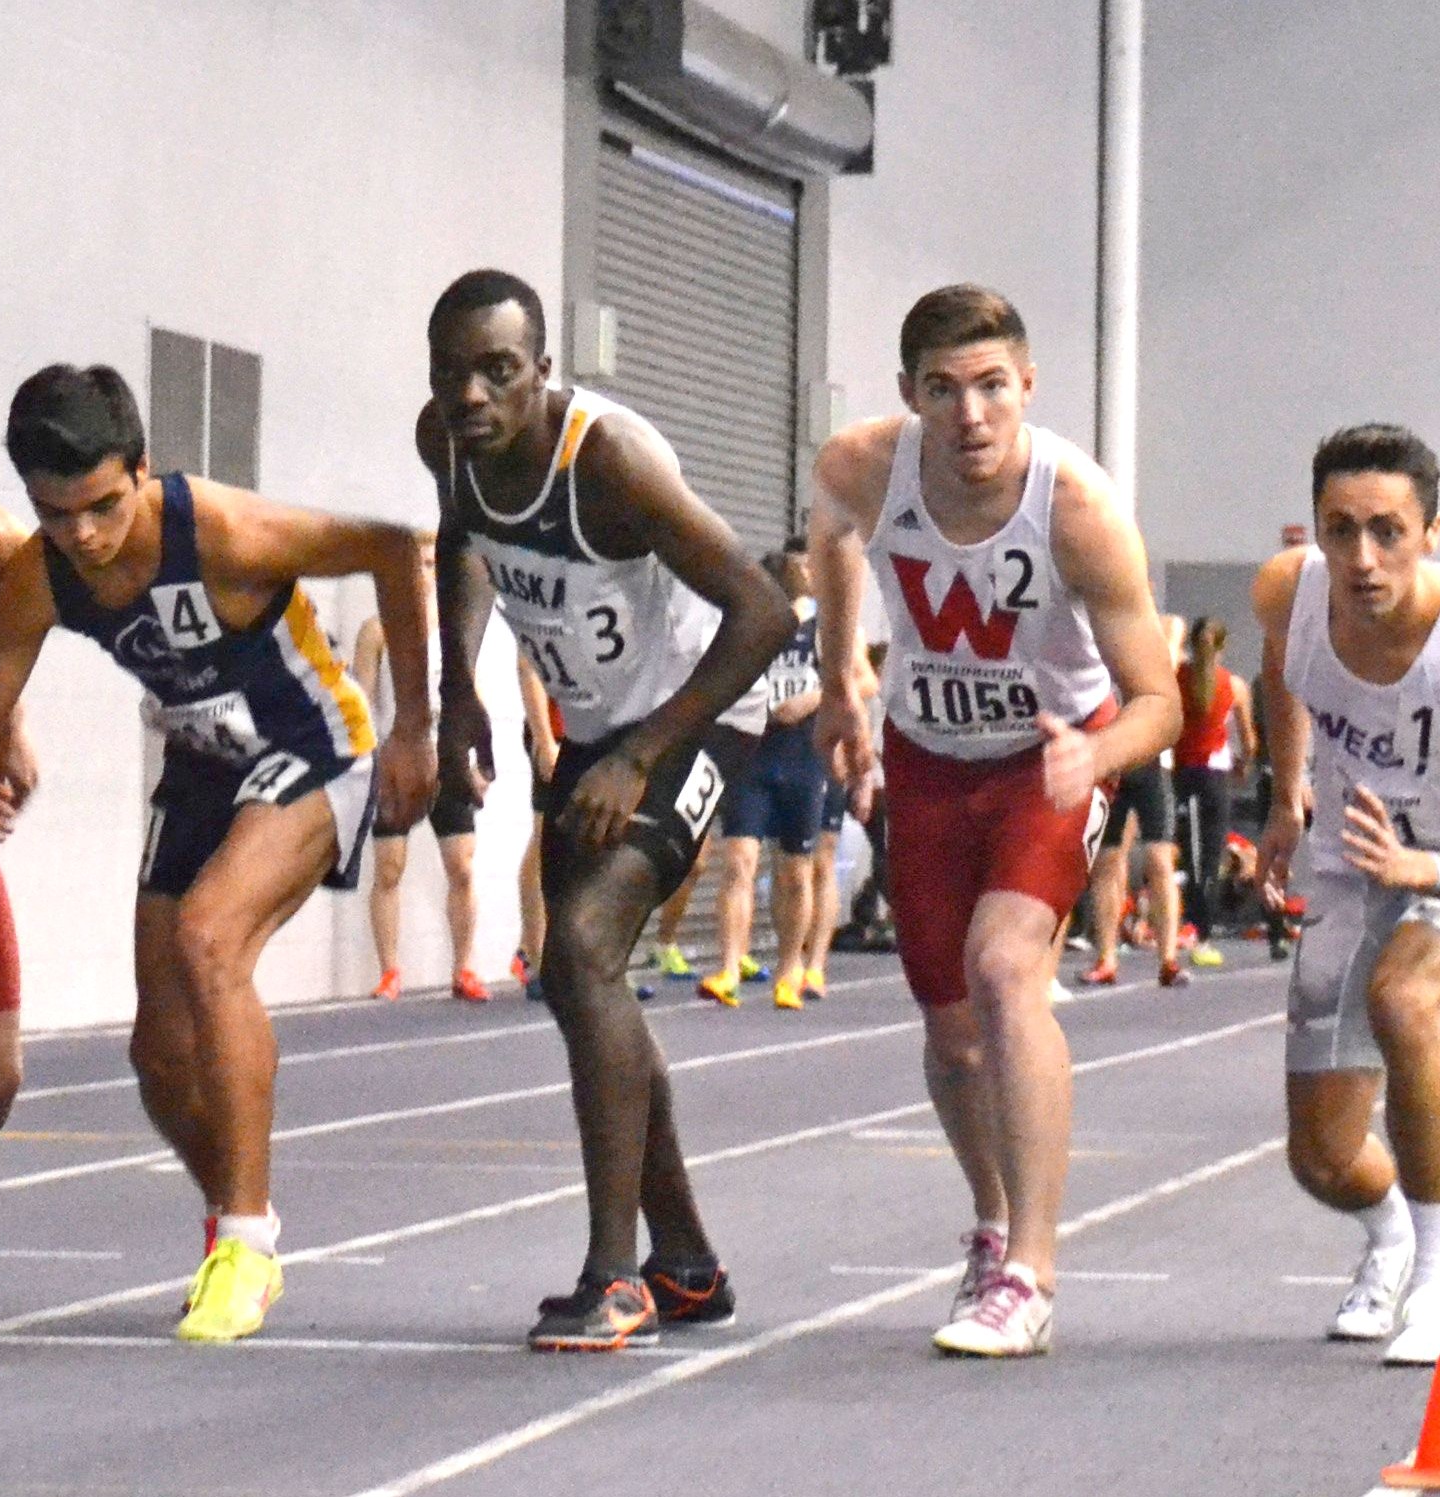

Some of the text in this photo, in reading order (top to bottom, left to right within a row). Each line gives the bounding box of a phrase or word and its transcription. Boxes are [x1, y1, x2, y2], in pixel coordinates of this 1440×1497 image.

[890, 552, 1021, 660] W
[1004, 549, 1039, 608] 2
[172, 590, 207, 640] 4
[587, 606, 625, 663] 3
[913, 675, 1039, 726] 1059
[1412, 706, 1434, 775] 1
[248, 759, 293, 791] 4
[685, 766, 715, 824] 3
